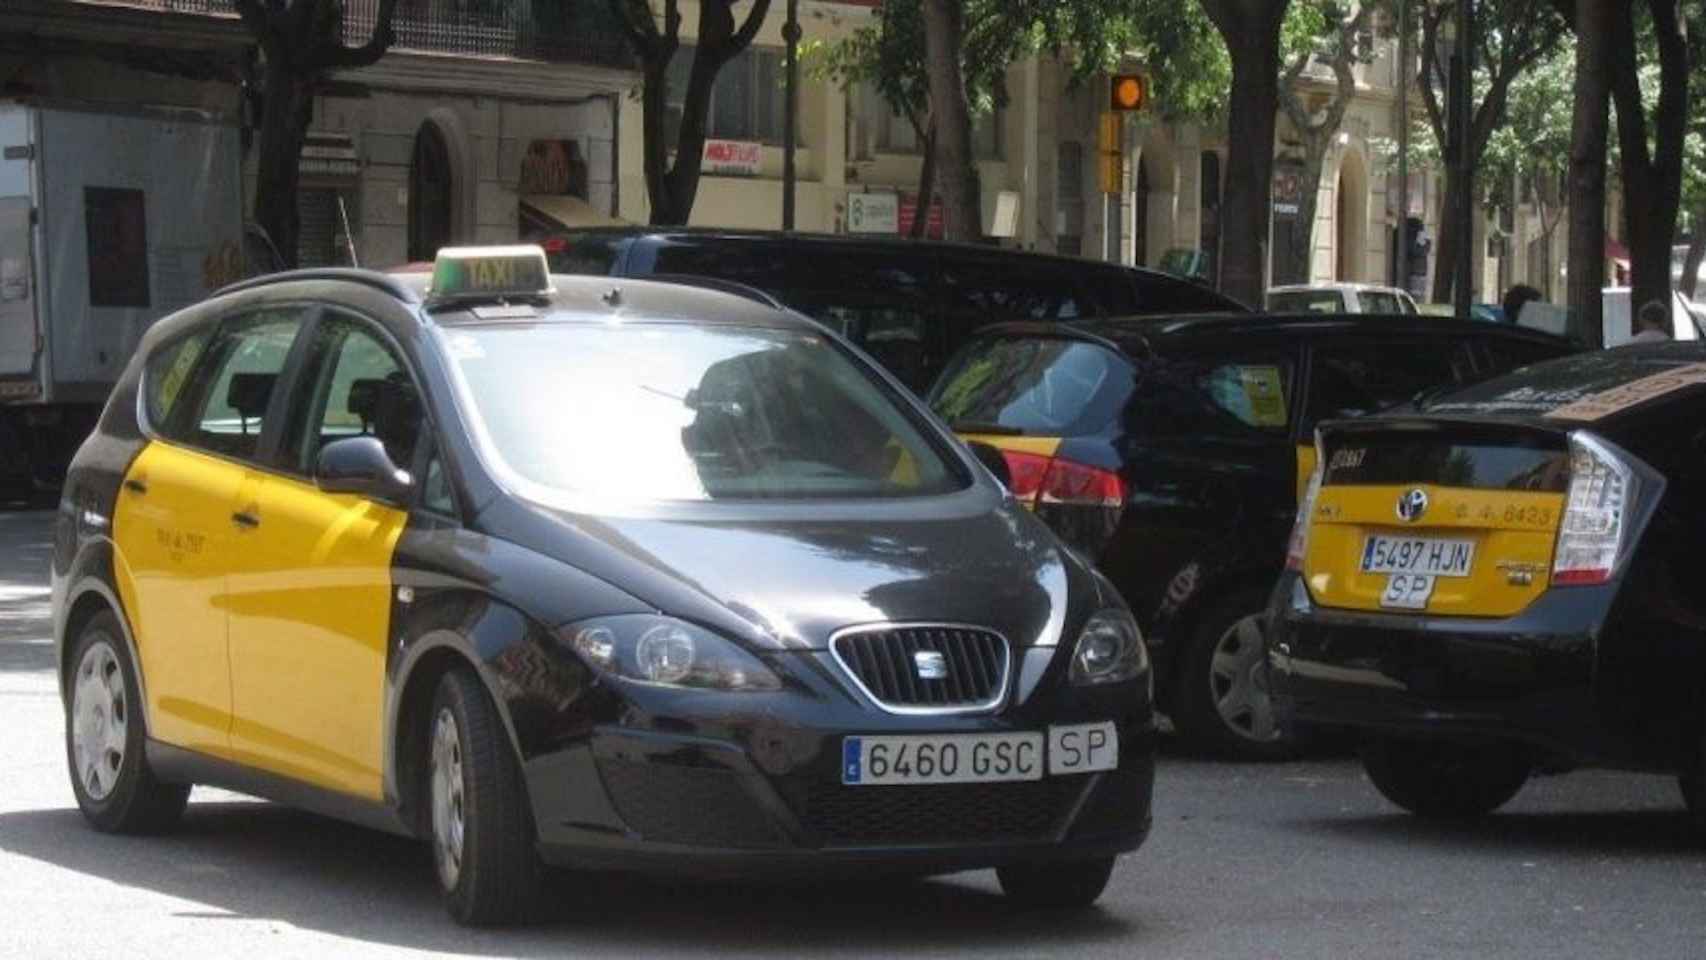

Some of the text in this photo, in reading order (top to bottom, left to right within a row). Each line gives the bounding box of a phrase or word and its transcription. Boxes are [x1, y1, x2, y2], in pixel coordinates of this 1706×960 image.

[468, 258, 514, 289] TAXI
[1374, 540, 1470, 572] 5497 HJN
[1386, 574, 1428, 604] SP
[868, 740, 1034, 778] 6460 GSC
[1060, 729, 1106, 768] SP
